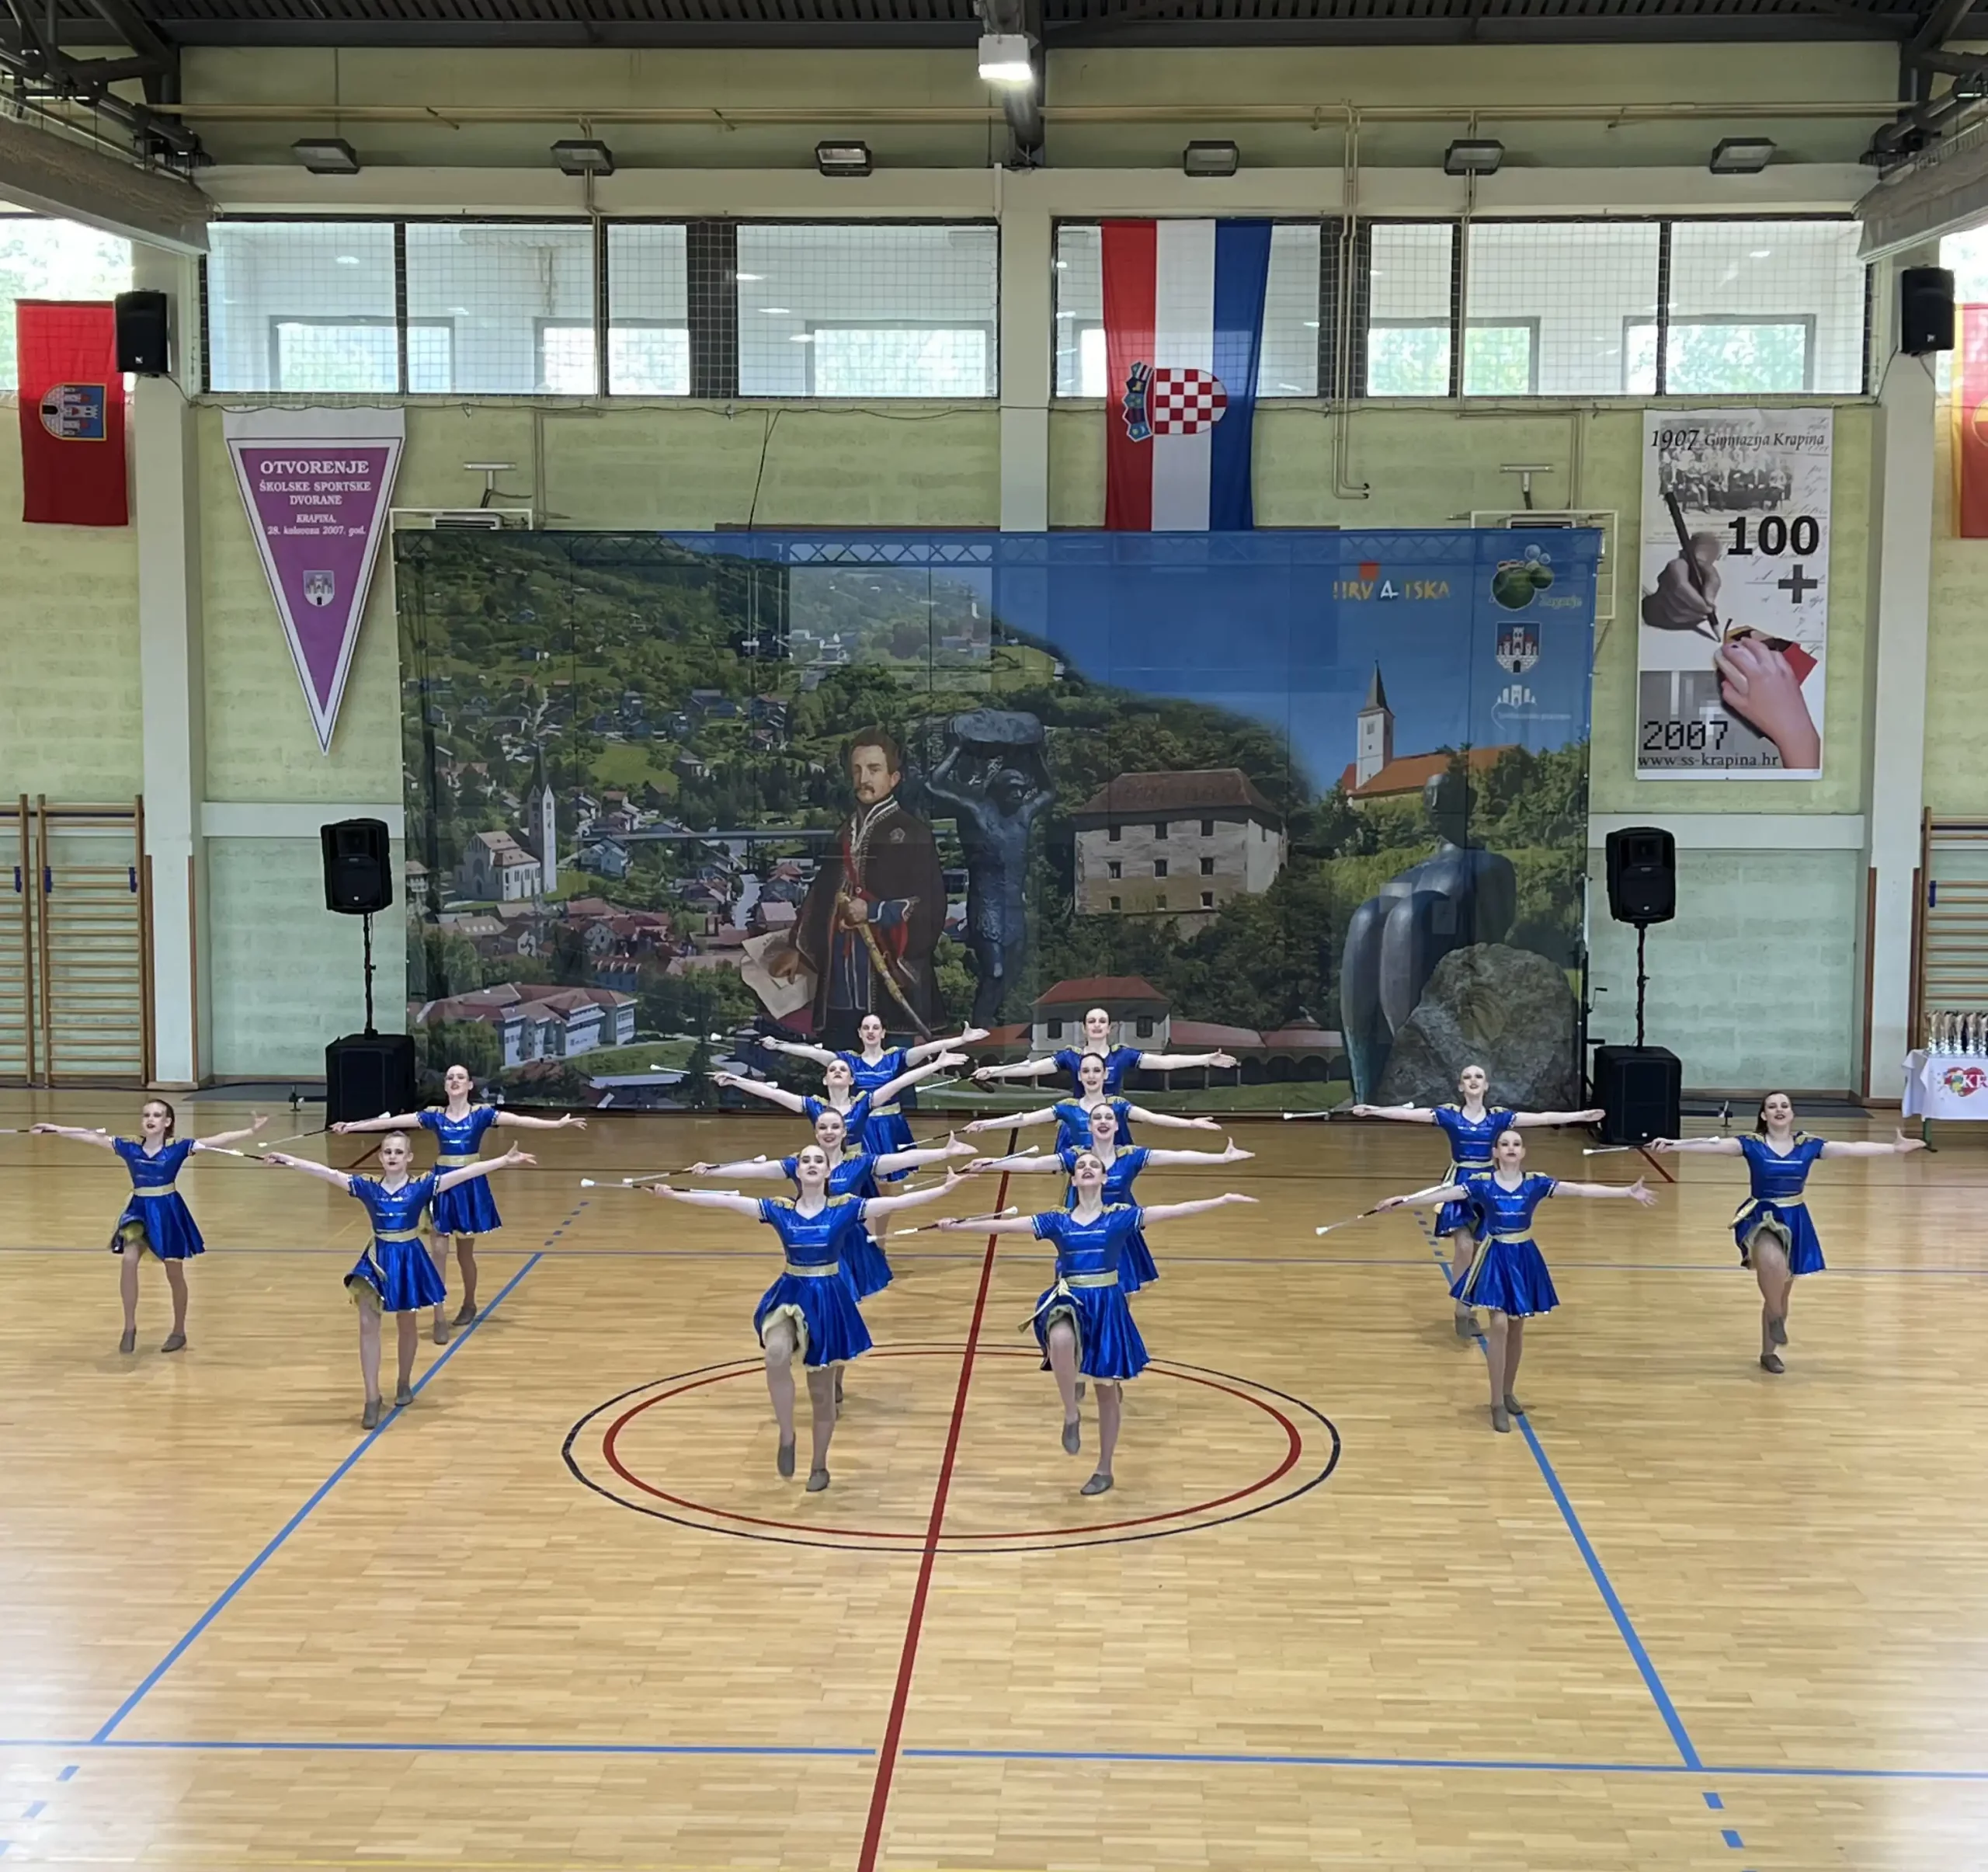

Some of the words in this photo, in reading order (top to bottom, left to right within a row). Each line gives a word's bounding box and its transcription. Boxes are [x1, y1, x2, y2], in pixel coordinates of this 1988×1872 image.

[1651, 430, 1699, 451] 1907
[1705, 433, 1770, 451] Gimnazija
[1773, 432, 1825, 451] Krapina
[260, 461, 369, 474] OTVORENJE
[259, 479, 310, 492] ŠKOLSKE
[314, 481, 371, 492] SPORTSKE
[290, 495, 342, 505] DVORANE
[1727, 516, 1819, 555] 100
[1643, 721, 1728, 750] 2007
[1638, 752, 1778, 768] www.ss-krapina.hr
